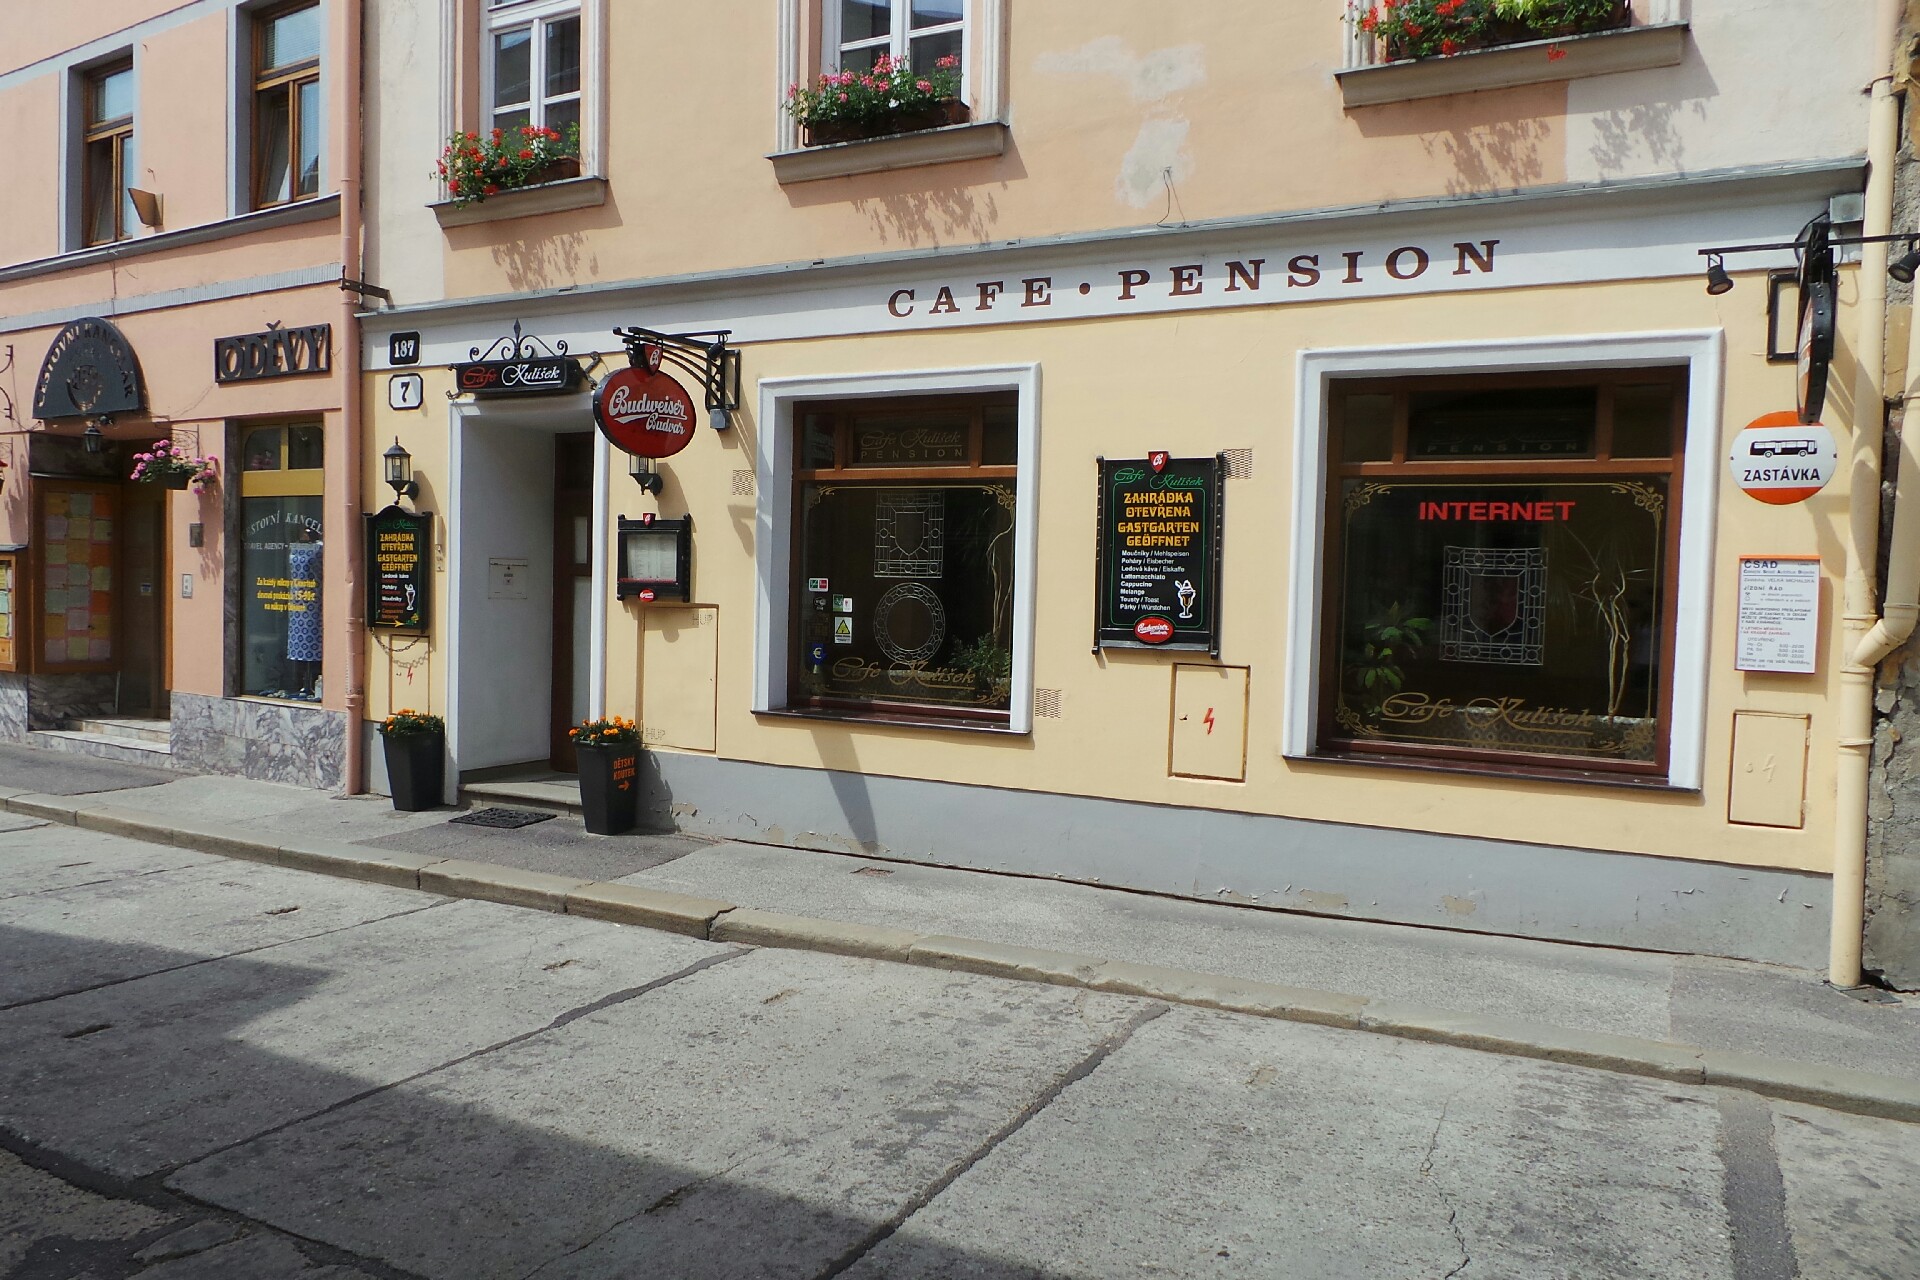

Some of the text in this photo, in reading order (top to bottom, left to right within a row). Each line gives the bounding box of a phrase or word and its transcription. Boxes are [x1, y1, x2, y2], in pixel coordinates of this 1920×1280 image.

[888, 239, 1500, 318] CAFE PENSION
[219, 320, 327, 379] ODĚVY
[394, 339, 415, 358] 187
[463, 366, 497, 388] Cafe
[400, 381, 411, 403] 7
[608, 385, 688, 418] Budweiser
[645, 412, 686, 436] Budvar
[861, 449, 963, 459] PENSION
[1427, 443, 1577, 453] PENSION
[1744, 465, 1821, 483] ZASTÁVKA
[1123, 490, 1195, 504] ZAHRÁDKA
[1125, 503, 1191, 518] OTEVŘENA
[1419, 501, 1576, 521] INTERNET
[1117, 522, 1200, 534] GASTGARTEN
[1126, 534, 1191, 547] GEÖFFNET
[832, 657, 881, 681] Cafe
[1380, 692, 1456, 723] Cafe
